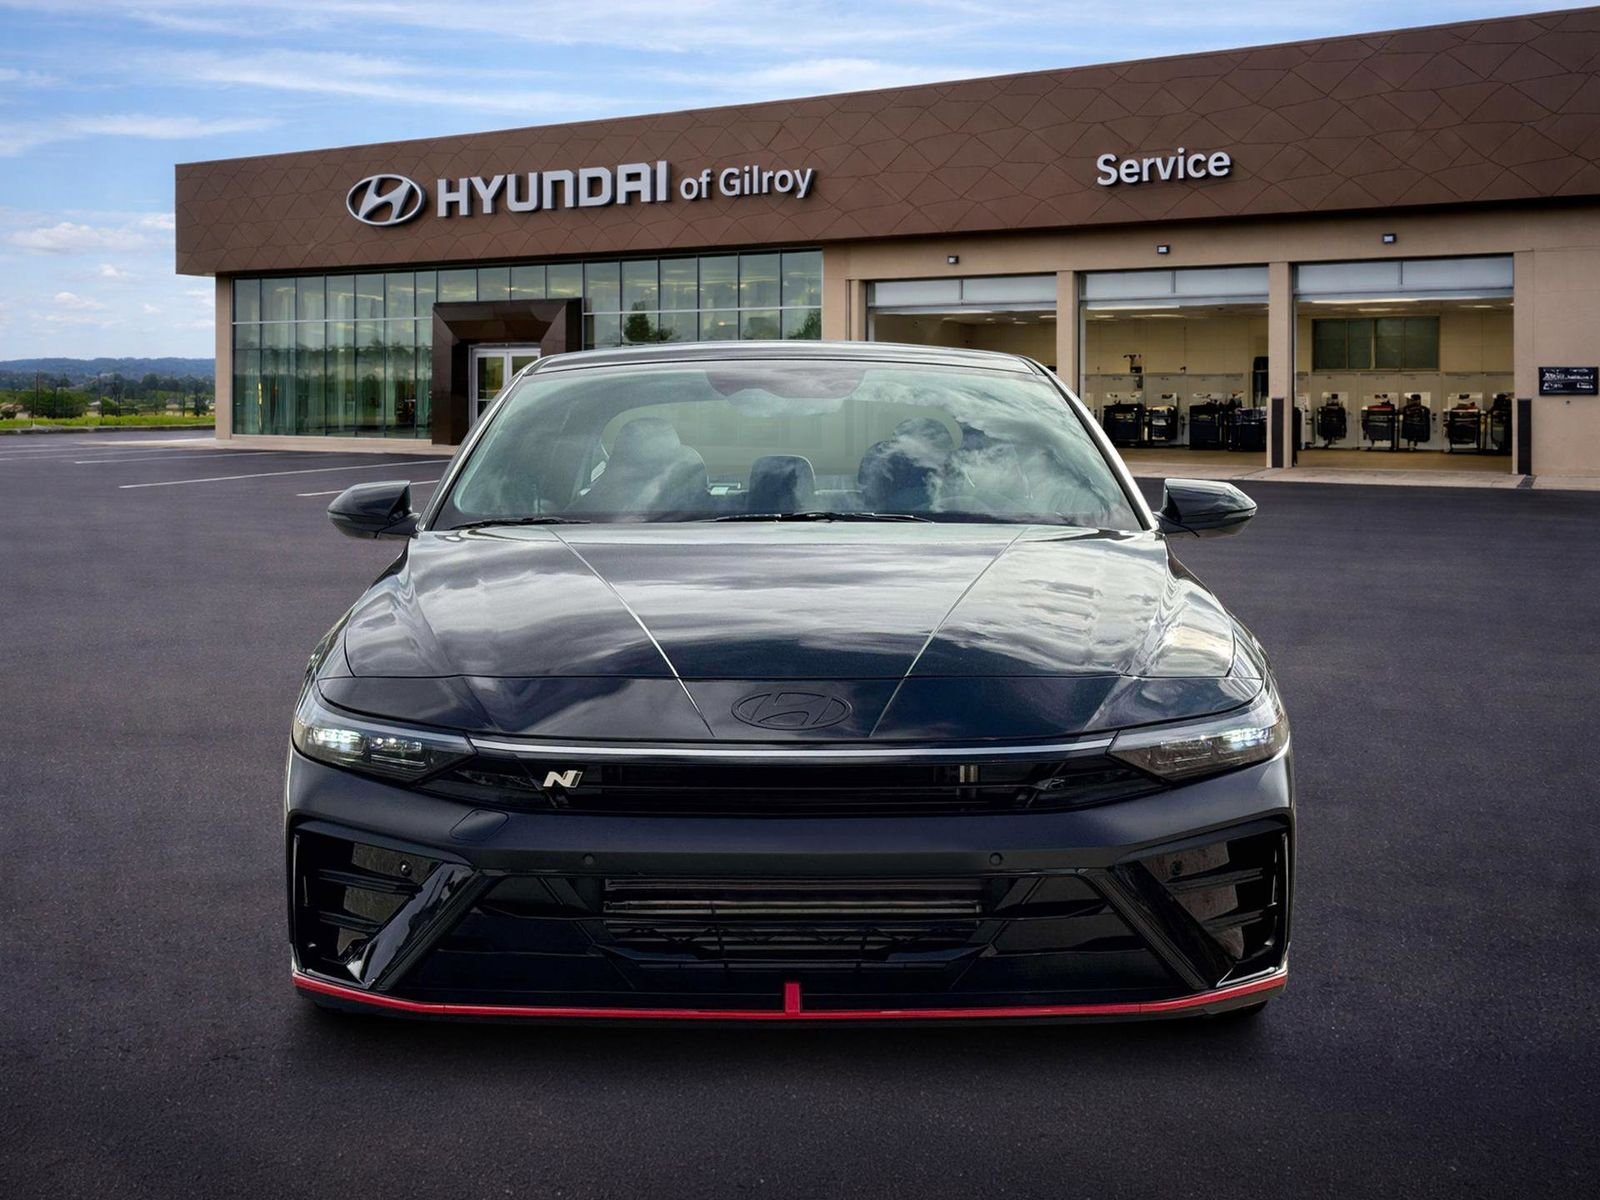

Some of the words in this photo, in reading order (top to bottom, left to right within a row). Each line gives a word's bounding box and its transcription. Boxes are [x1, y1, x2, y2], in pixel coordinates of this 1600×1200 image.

[436, 160, 669, 217] HYUNDAI
[680, 169, 713, 200] of
[719, 164, 813, 198] Gilroy
[1096, 147, 1231, 186] Service
